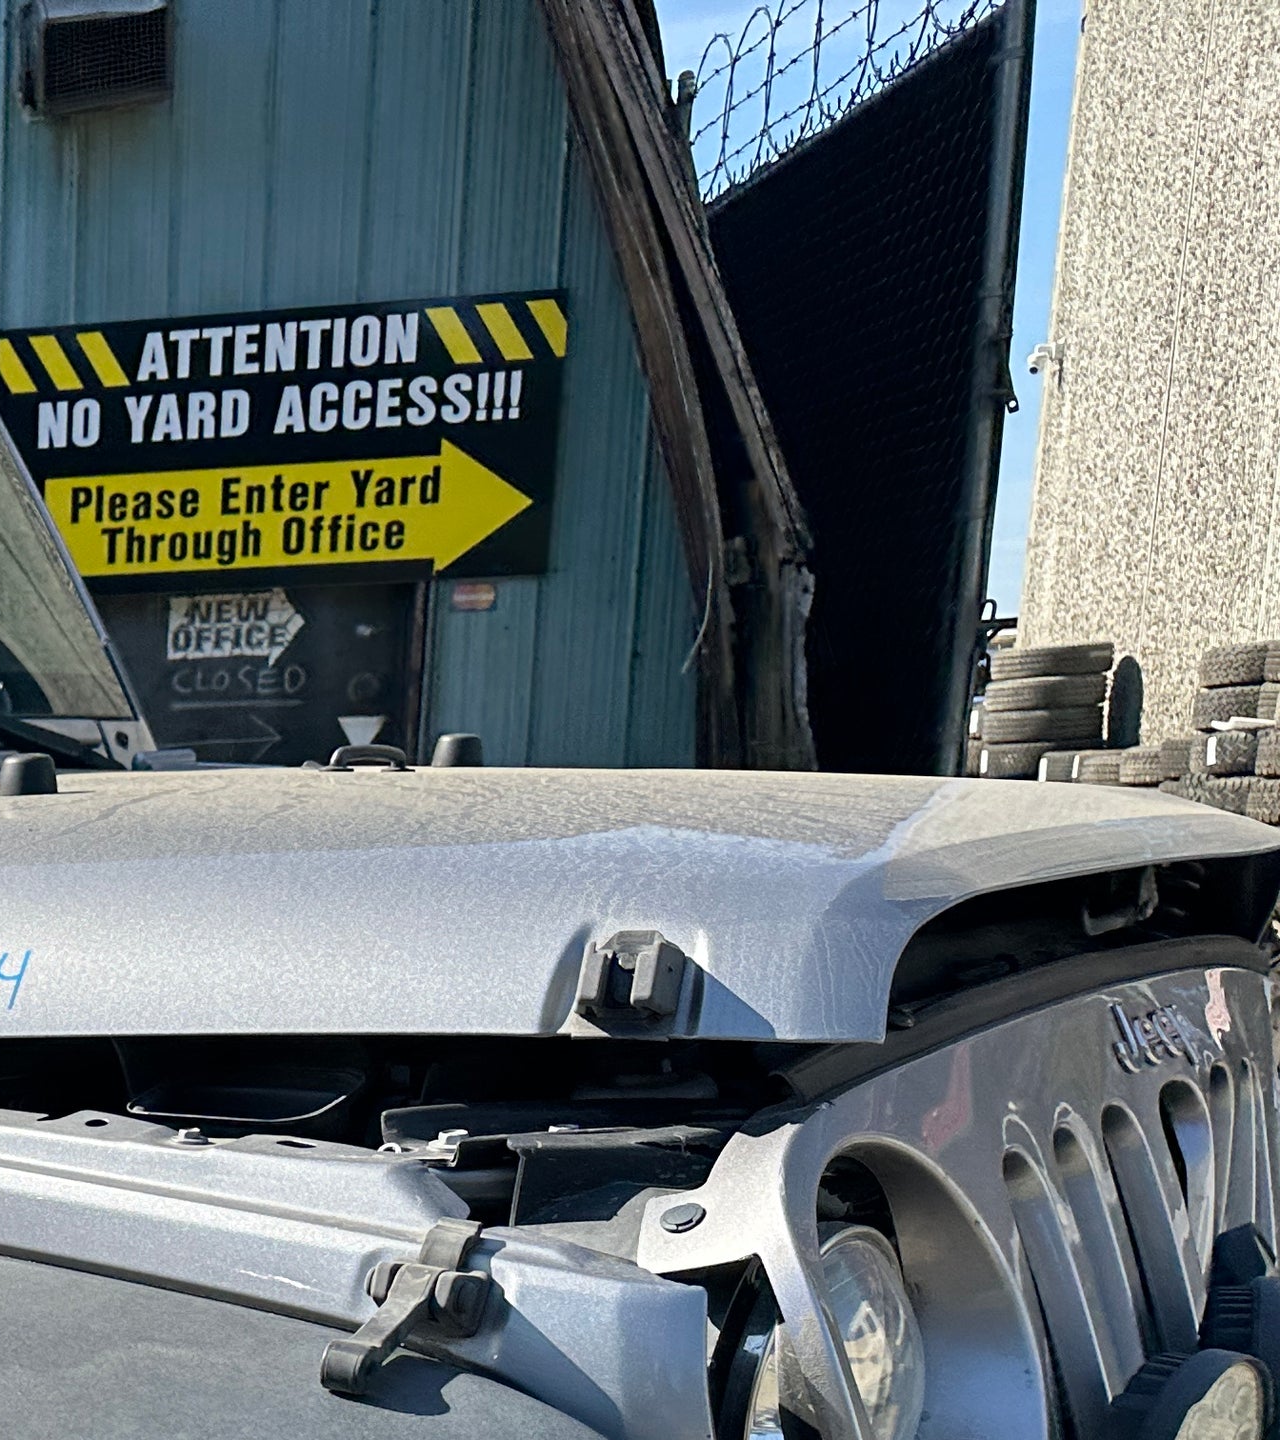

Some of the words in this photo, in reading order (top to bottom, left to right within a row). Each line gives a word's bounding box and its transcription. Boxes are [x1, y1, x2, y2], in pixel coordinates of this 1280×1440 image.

[137, 313, 419, 382] ATTENTION
[38, 401, 100, 449] NO
[125, 391, 249, 443] YARD
[274, 370, 523, 434] ACCESS!!!
[70, 480, 199, 523] Please
[221, 473, 330, 515] Enter
[351, 466, 440, 506] Yard
[101, 522, 261, 567] Through
[282, 515, 405, 556] Office
[172, 623, 288, 650] OFFICE
[186, 599, 270, 623] NEW
[1110, 1002, 1201, 1074] Jeep
